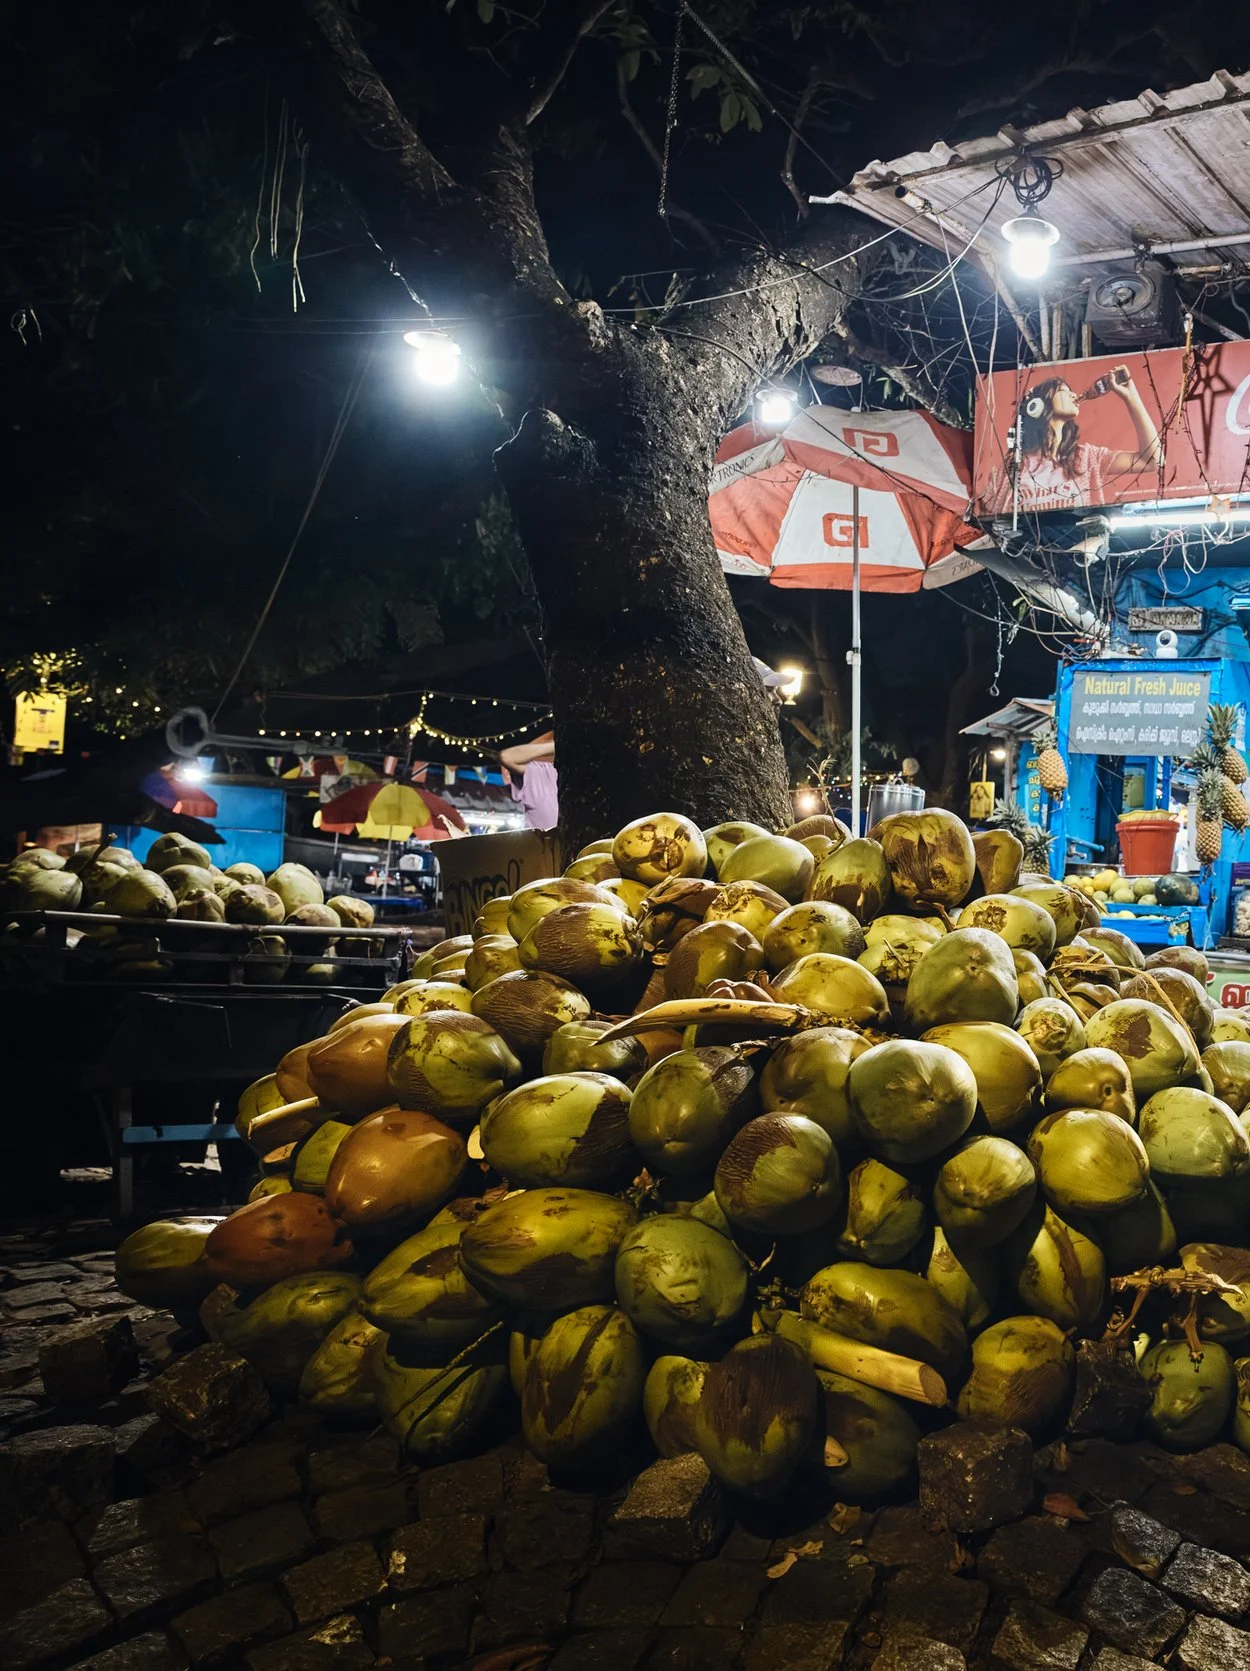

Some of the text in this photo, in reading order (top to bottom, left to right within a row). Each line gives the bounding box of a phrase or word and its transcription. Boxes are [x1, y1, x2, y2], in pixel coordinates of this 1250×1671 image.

[1084, 676, 1201, 696] Natural Fresh Juice
